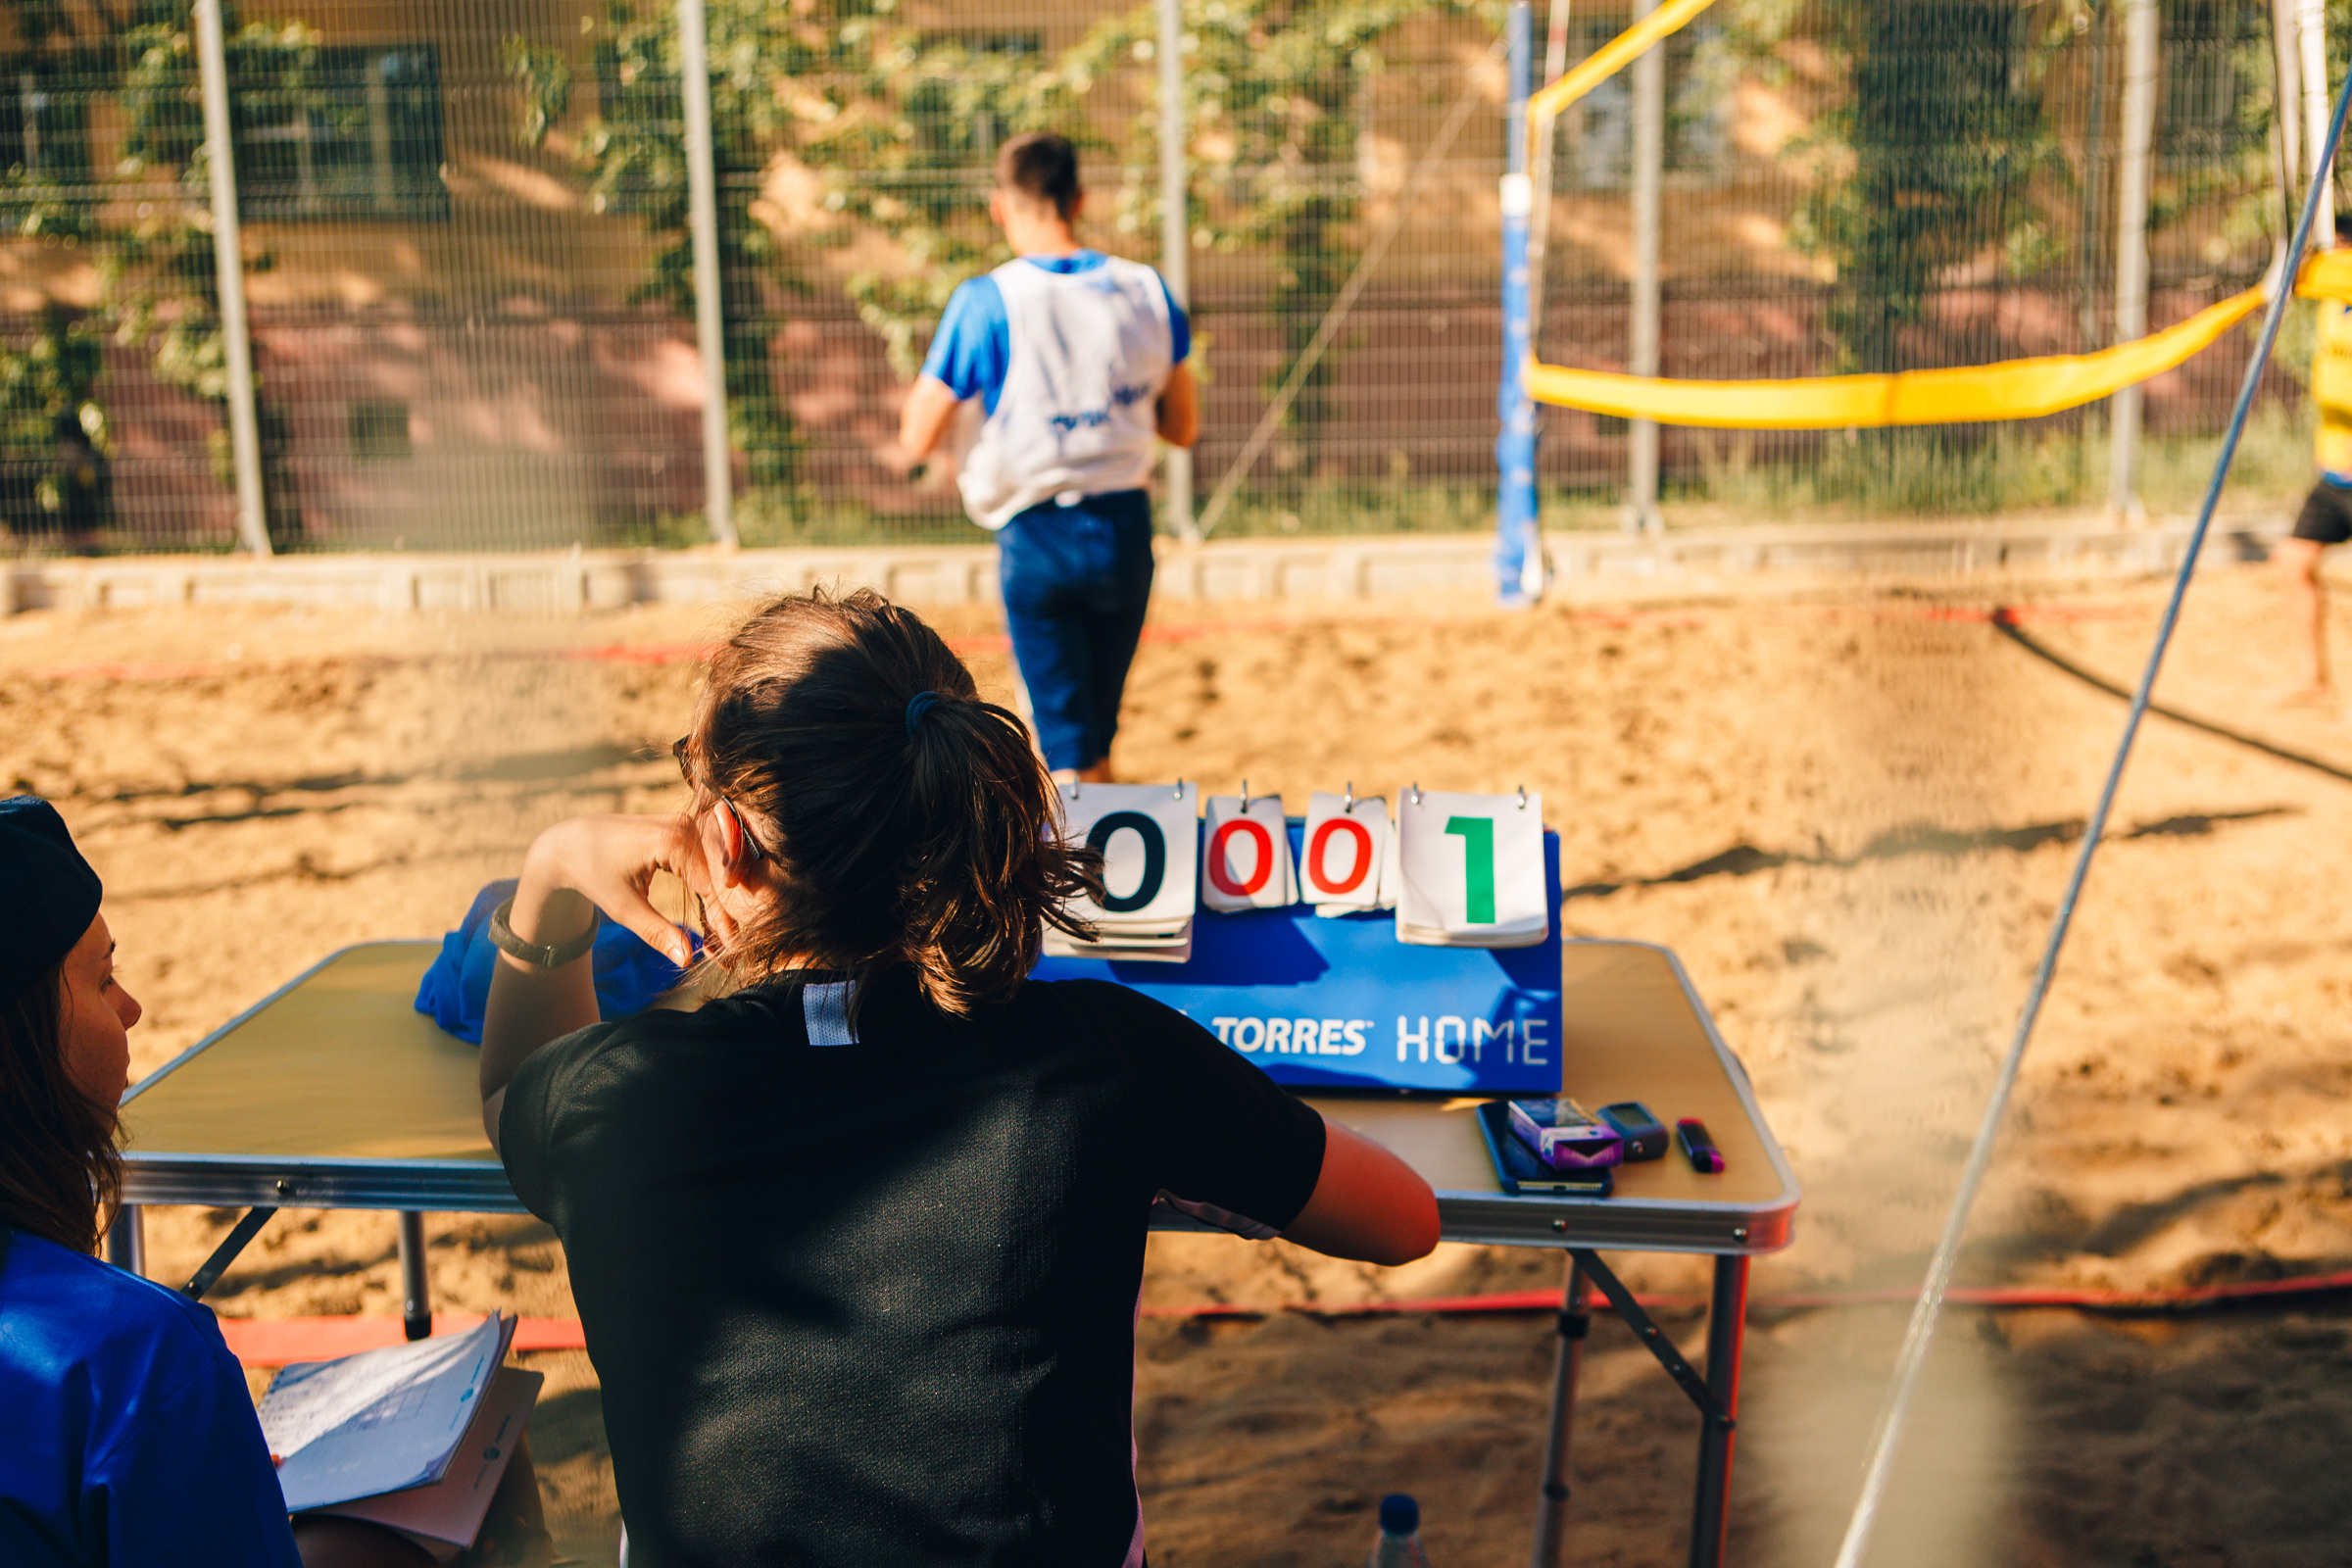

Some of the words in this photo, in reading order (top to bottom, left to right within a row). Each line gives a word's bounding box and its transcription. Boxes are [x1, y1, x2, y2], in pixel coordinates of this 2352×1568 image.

[1084, 809, 1166, 913] 0
[1208, 818, 1274, 897] 0
[1307, 817, 1373, 895] 0
[1444, 814, 1496, 925] 1
[1211, 1016, 1367, 1055] TORRES
[1396, 1014, 1548, 1065] HOME
